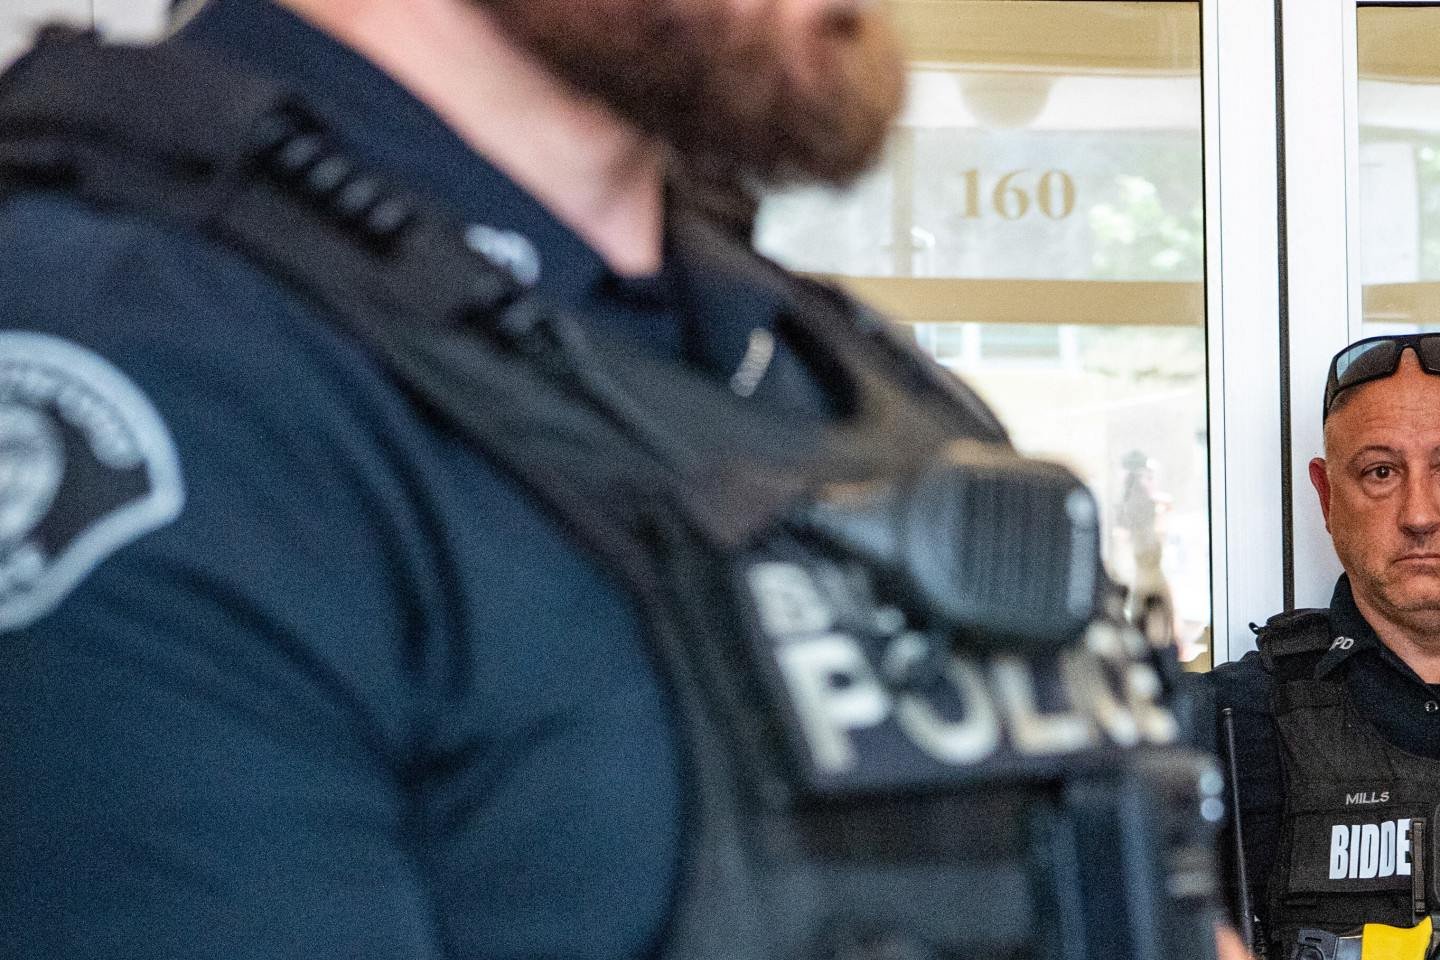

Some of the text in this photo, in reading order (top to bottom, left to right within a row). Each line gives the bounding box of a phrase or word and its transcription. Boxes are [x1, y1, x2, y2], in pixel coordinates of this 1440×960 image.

[960, 167, 1076, 221] 160
[1345, 791, 1390, 805] MILLS
[1328, 818, 1412, 880] BIDDE
